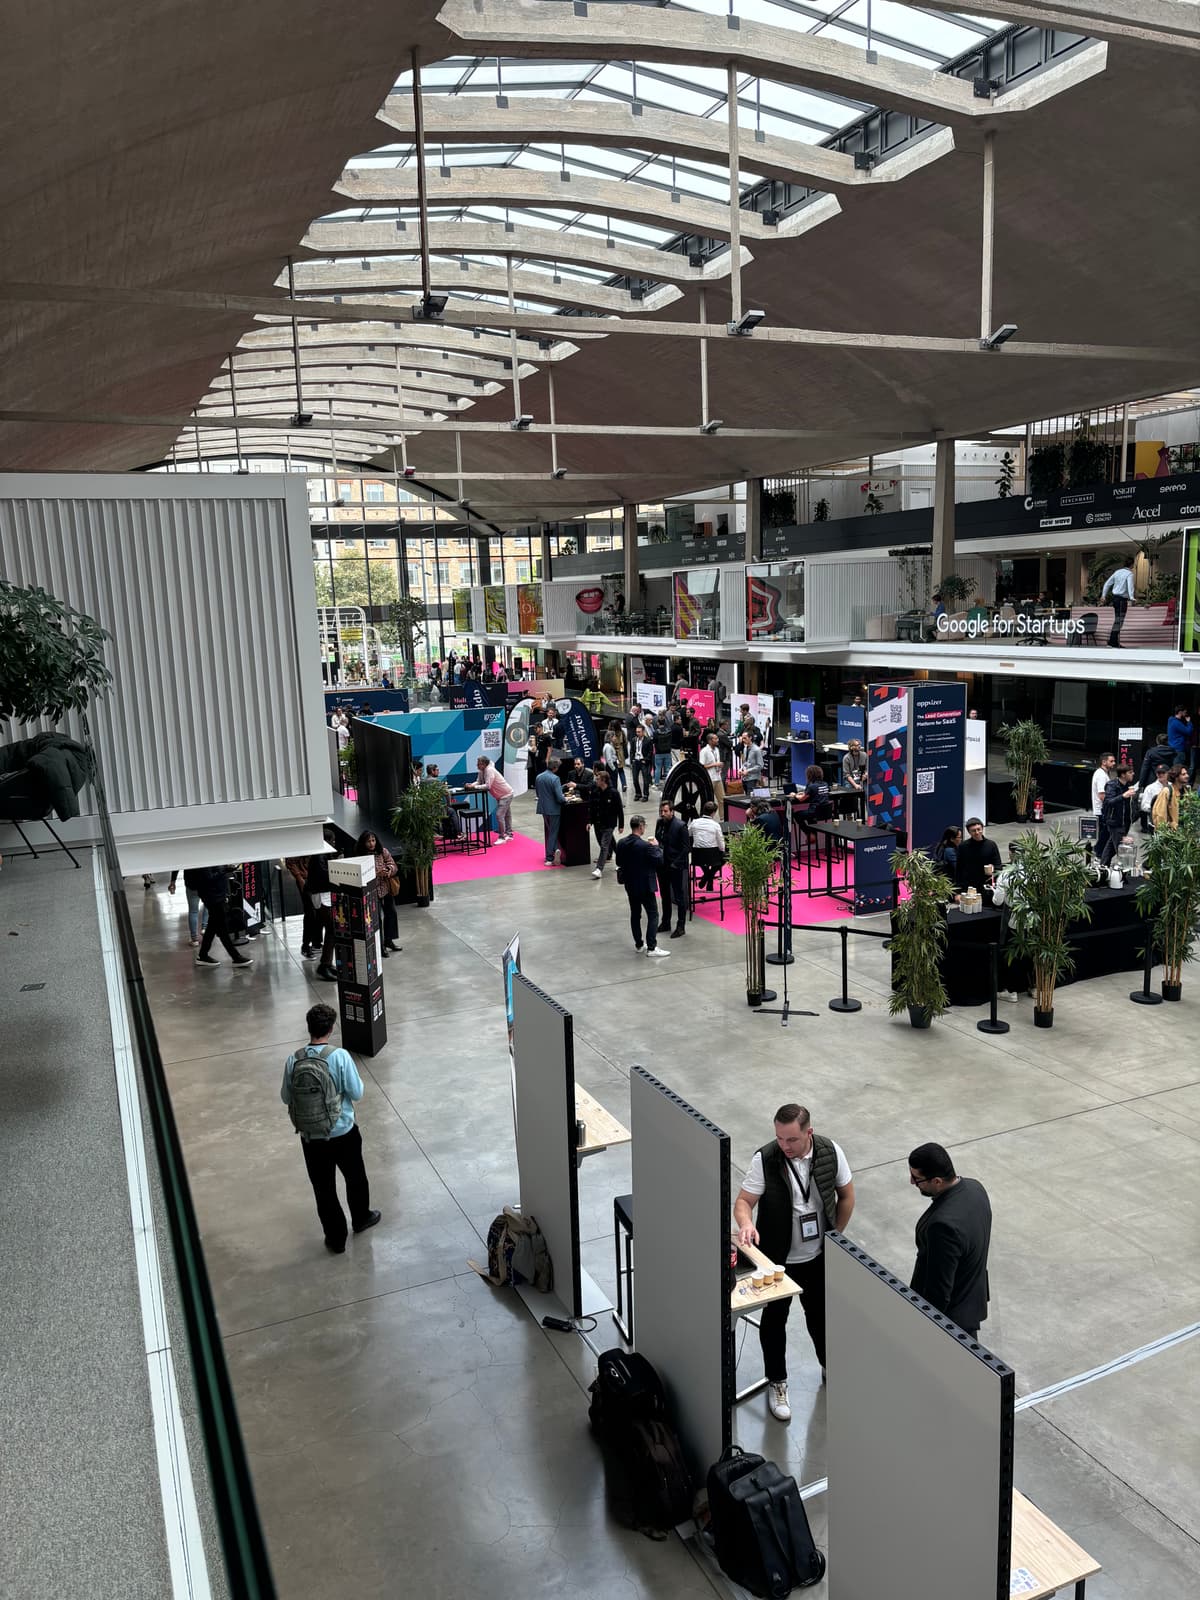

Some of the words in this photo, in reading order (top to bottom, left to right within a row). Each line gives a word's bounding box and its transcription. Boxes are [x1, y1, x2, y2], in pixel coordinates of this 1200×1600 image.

[1132, 504, 1160, 519] Accel
[936, 613, 989, 638] Google
[992, 613, 1014, 633] for
[1017, 613, 1085, 639] Startups
